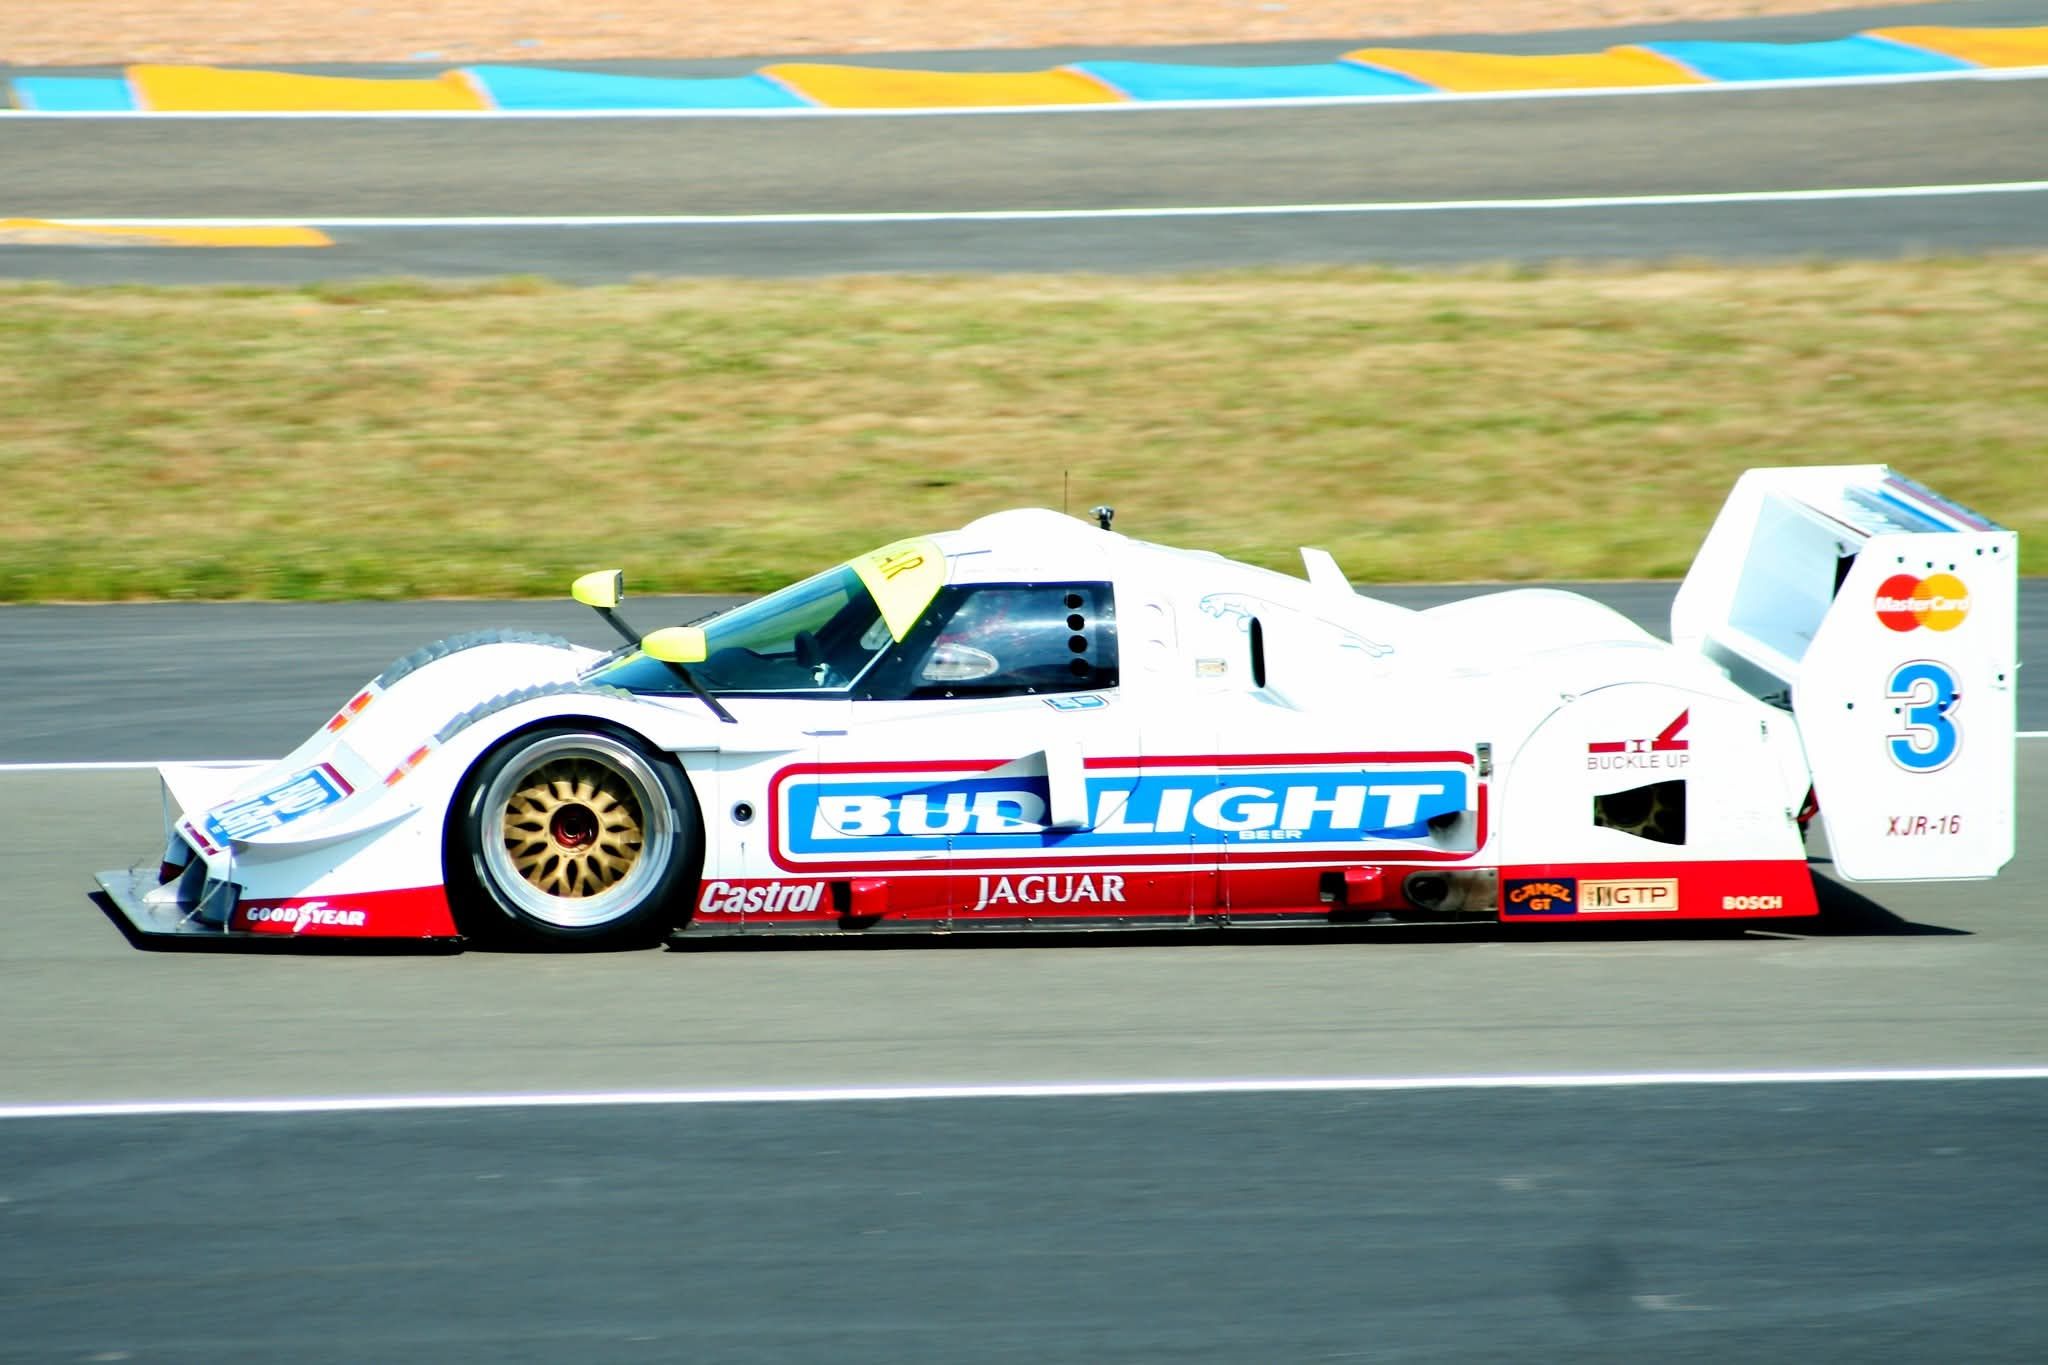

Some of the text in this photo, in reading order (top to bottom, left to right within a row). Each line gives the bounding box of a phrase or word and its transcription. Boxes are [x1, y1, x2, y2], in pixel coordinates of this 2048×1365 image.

[1885, 659, 1962, 774] 3
[1587, 754, 1690, 770] BUCKLE UP
[810, 784, 1444, 840] BUD LIGHT
[1238, 829, 1302, 840] BEER
[1886, 815, 1961, 836] XJR-16
[699, 880, 826, 914] Castrol
[973, 875, 1126, 911] JAGUAR
[1510, 882, 1573, 903] CAMEL
[1614, 887, 1668, 904] GTP
[1722, 895, 1782, 910] BOSCH
[1529, 898, 1553, 911] GT
